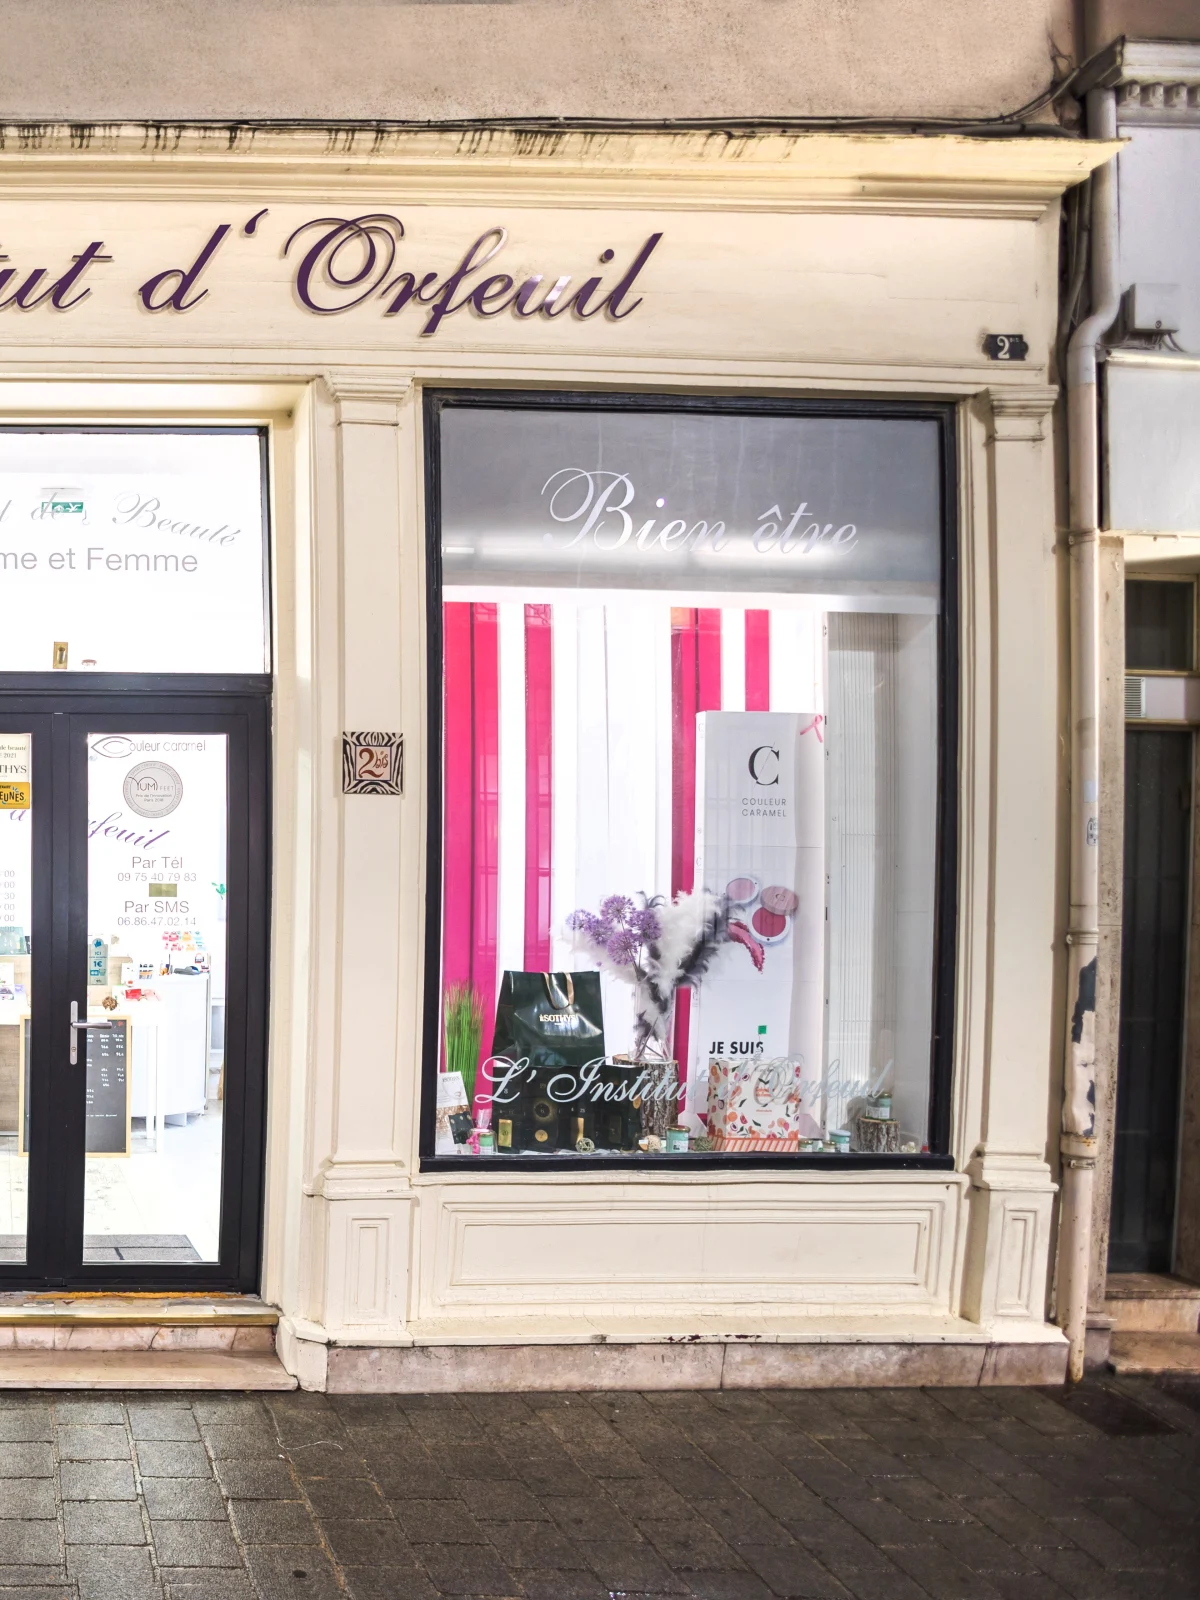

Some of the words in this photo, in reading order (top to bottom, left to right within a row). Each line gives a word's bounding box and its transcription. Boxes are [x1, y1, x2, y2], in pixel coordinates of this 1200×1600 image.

[996, 336, 1010, 359] 2
[541, 468, 729, 553] Bien
[752, 503, 859, 555] être
[112, 491, 242, 547] Beauté
[49, 549, 76, 570] et
[87, 547, 199, 572] Femme
[742, 798, 787, 806] COULEUR
[742, 808, 787, 817] CARAMEL
[132, 856, 156, 868] Par
[161, 856, 183, 868] Tél
[118, 872, 130, 882] 09
[135, 872, 148, 882] 75
[151, 872, 164, 882] 40
[168, 872, 180, 882] 79
[184, 872, 196, 882] 83
[124, 900, 150, 913] Par
[154, 900, 190, 913] SMS
[709, 1042, 724, 1054] JE
[730, 1041, 764, 1054] SUIS
